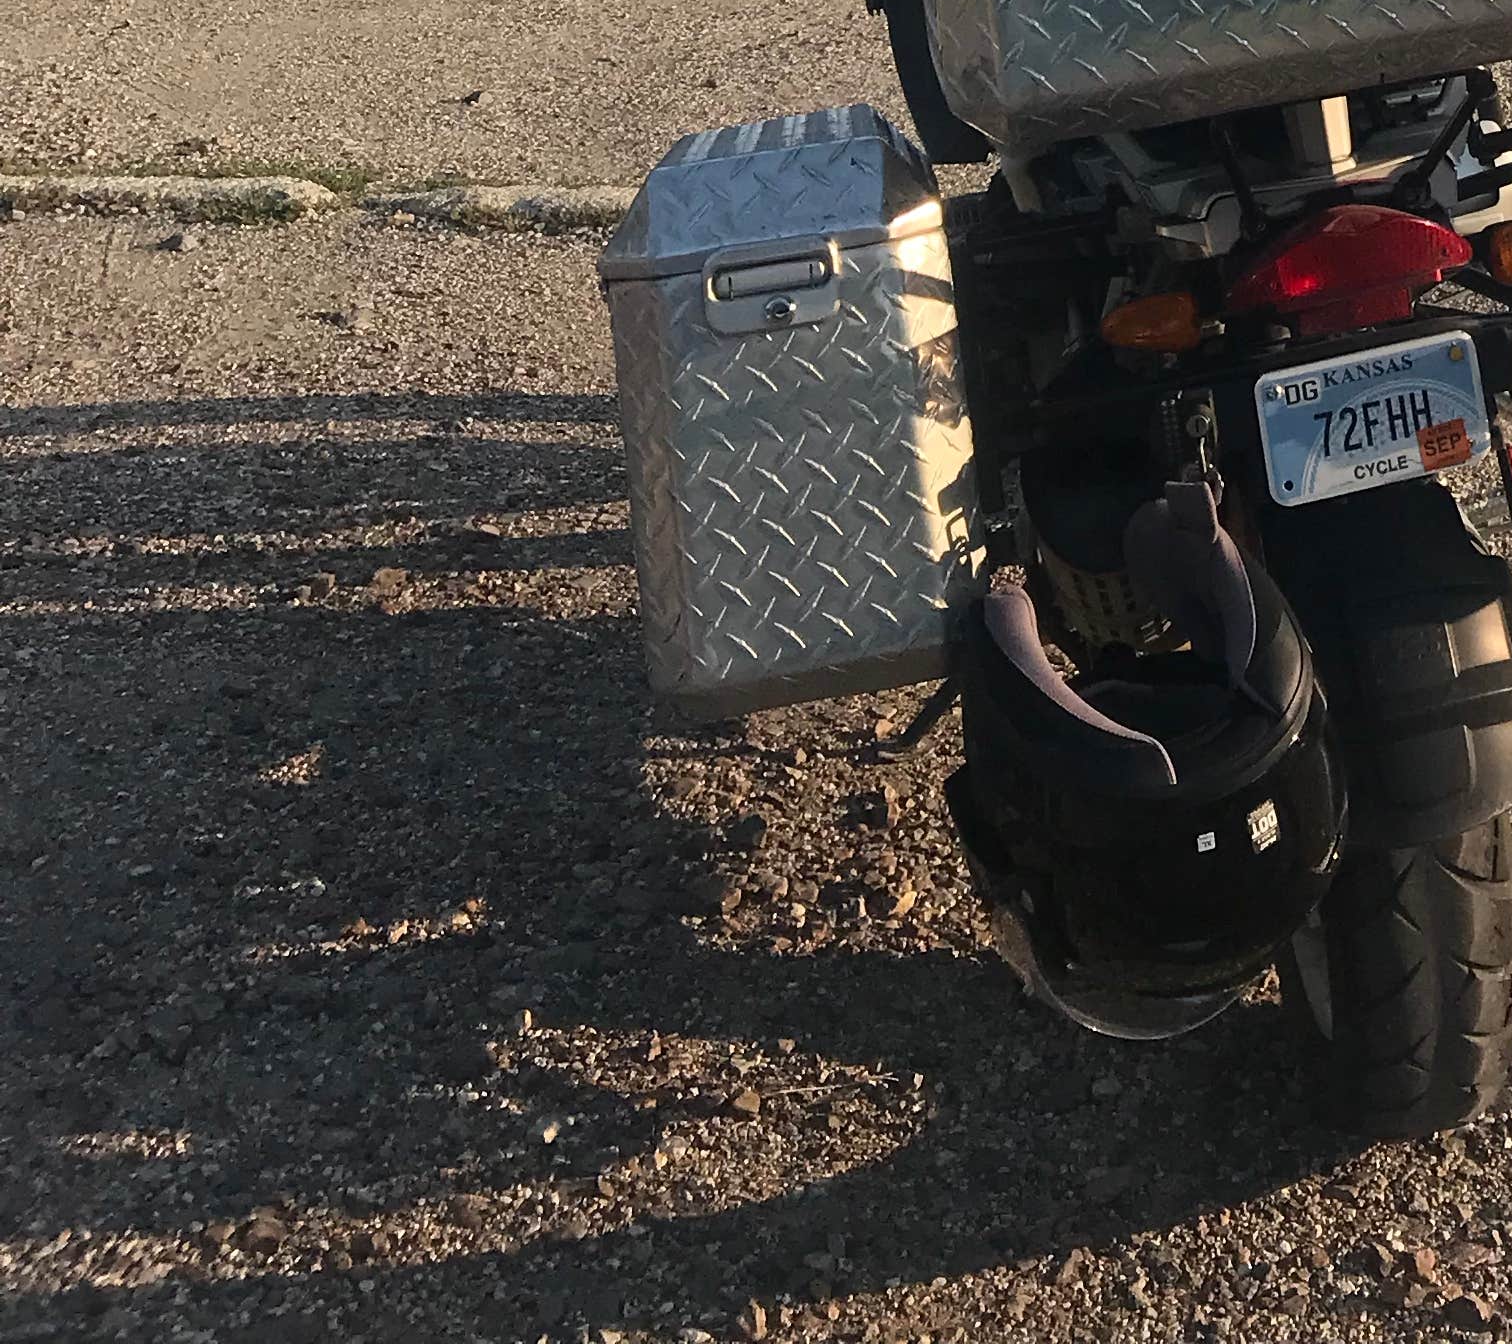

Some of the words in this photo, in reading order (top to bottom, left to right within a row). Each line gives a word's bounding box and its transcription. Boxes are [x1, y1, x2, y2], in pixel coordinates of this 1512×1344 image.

[1323, 354, 1414, 387] KANSAS
[1285, 380, 1319, 405] DG
[1313, 390, 1432, 457] 72FHH
[1424, 432, 1461, 456] SEP
[1354, 456, 1408, 479] CYCLE
[1251, 809, 1278, 840] DOT
